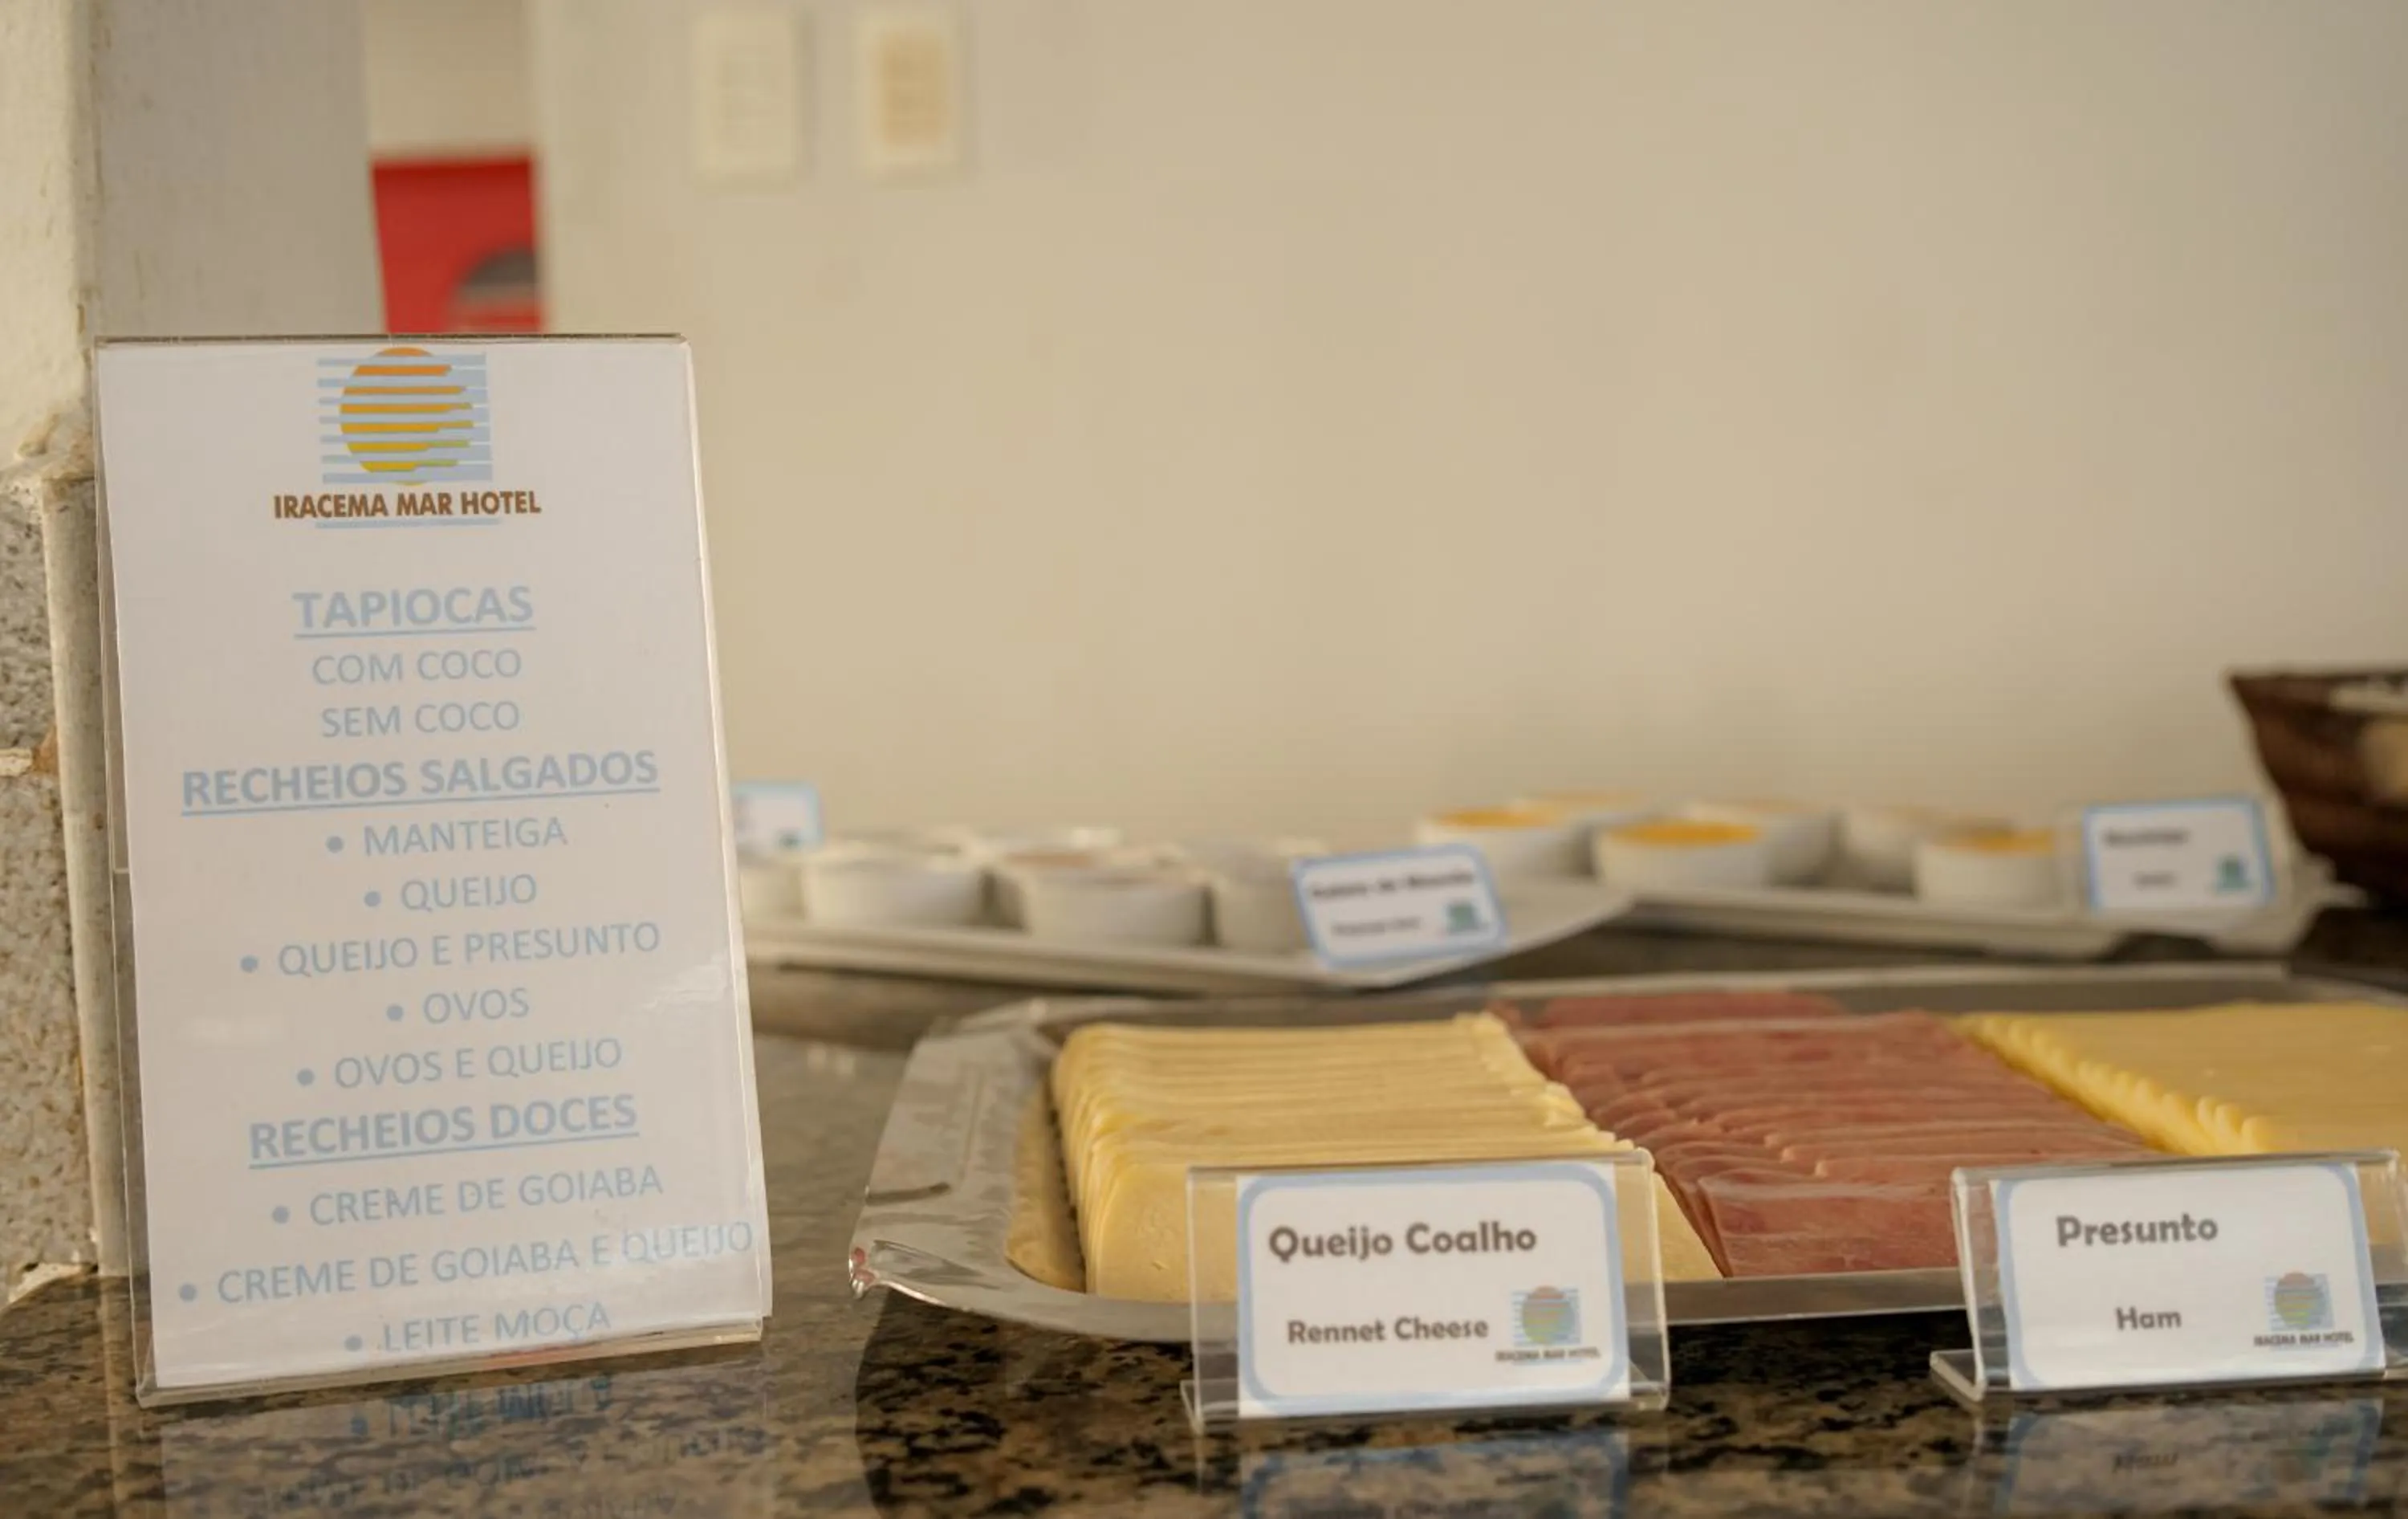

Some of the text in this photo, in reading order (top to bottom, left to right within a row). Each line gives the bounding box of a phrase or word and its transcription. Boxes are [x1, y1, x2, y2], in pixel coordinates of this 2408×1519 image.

[274, 491, 541, 519] IRACEMA MAR HOTEL
[292, 587, 534, 630] TAPIOCAS
[312, 650, 521, 684] COM COCO
[322, 702, 519, 738] SEM COCO
[182, 751, 659, 806] RECHEIOS SALGADOS
[364, 817, 568, 857] MANTEIGA
[401, 874, 537, 912] QUEIJO
[279, 922, 661, 979] QUEIJO E PRESUNTO
[423, 988, 530, 1024] OVOS
[334, 1038, 622, 1088] OVOS E QUEIJO
[250, 1095, 637, 1159] RECHEIOS DOCES
[310, 1166, 663, 1226] CREME DE GOIABA
[1269, 1221, 1537, 1262] Queijo Coalho
[2056, 1214, 2219, 1247] Presunto
[218, 1221, 753, 1304] CREME DE GOIABA E QUEIJO
[384, 1302, 611, 1353] LEITE MOÇA
[1287, 1317, 1488, 1345] Rennet Cheese
[2115, 1308, 2182, 1330] Ham
